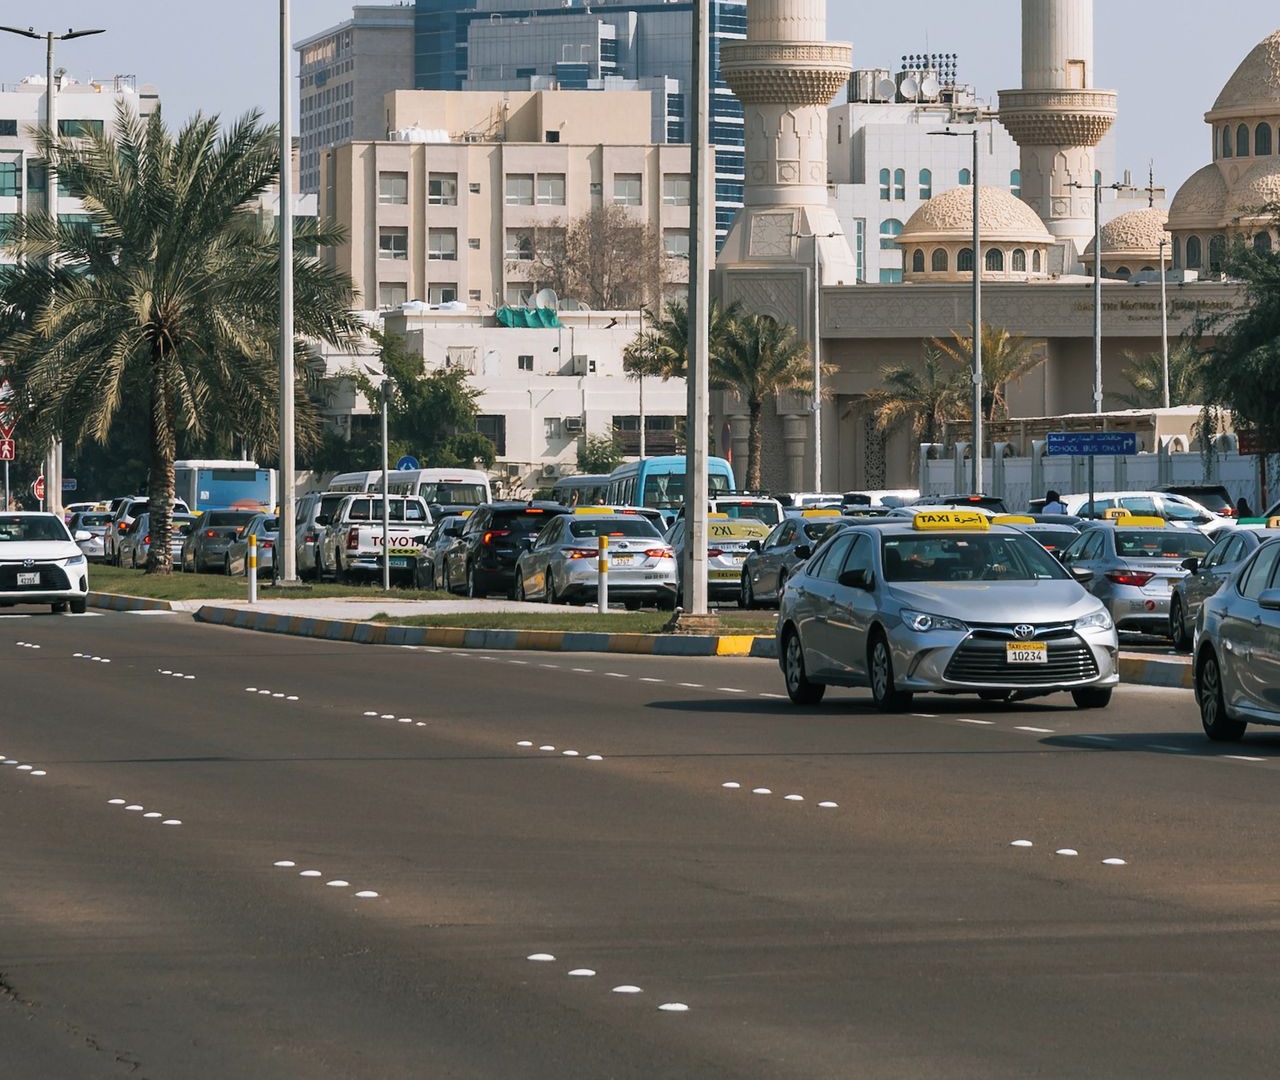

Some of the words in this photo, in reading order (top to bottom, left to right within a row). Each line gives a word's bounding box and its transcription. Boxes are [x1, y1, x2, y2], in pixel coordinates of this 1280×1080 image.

[1049, 445, 1079, 453] SCHOOL
[918, 515, 950, 523] TAXI
[954, 513, 982, 524] أجرة
[711, 526, 736, 536] 2XL
[371, 536, 420, 547] TYOT
[1012, 651, 1042, 661] 10234
